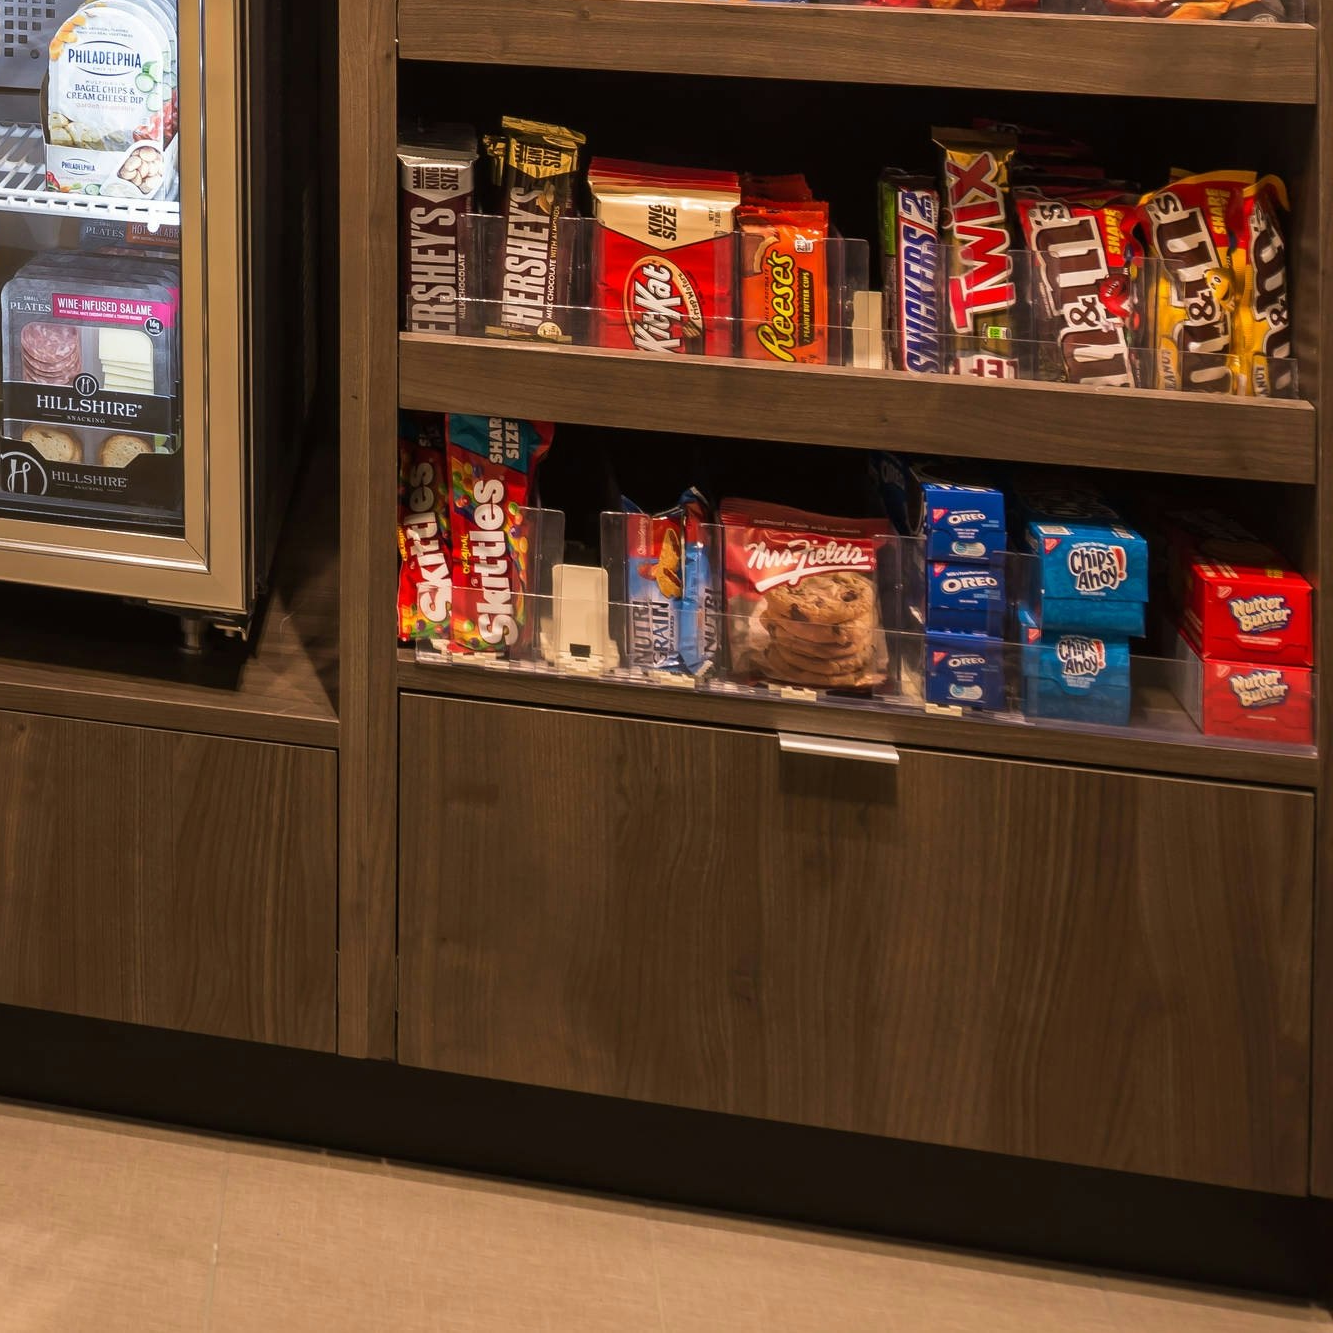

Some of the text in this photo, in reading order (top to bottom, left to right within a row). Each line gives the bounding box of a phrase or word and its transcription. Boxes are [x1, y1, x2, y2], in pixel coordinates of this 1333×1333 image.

[68, 48, 142, 68] PHILADELPHIA
[441, 168, 459, 191] SIZE
[551, 205, 560, 240] ALMONDS
[1204, 188, 1227, 235] SHARE
[85, 226, 125, 238] PLATES
[949, 153, 1015, 331] TWIX
[1102, 208, 1123, 256] SHARE
[501, 187, 551, 327] HERSHEY'S
[458, 253, 466, 301] CHOCOLATE
[547, 259, 557, 302] CHOCOLATE
[807, 272, 815, 288] CUPS
[10, 302, 52, 313] PLATES
[57, 297, 118, 313] WINE-INFUSED
[120, 303, 153, 317] SALAME
[546, 302, 555, 320] MILK
[757, 250, 795, 363] Reese's
[805, 288, 814, 313] BUTTER
[903, 226, 939, 374] SNICKERS
[805, 313, 813, 338] PEANUT
[37, 394, 138, 418] HILLSHIRE
[66, 416, 106, 425] SNACKING
[505, 420, 520, 460] SIZE
[51, 470, 128, 488] HILLSHIRE
[948, 512, 986, 526] OREO
[406, 462, 453, 622] Skittles
[469, 479, 519, 646] Skittles
[789, 539, 869, 585] Fields
[1069, 548, 1115, 570] Chips
[941, 575, 998, 594] OREO
[1232, 596, 1285, 617] Nutter
[634, 600, 648, 665] NUTRI
[652, 599, 670, 666] GRAIN
[702, 588, 720, 654] NUTRI
[1238, 611, 1291, 632] Butter
[948, 655, 986, 668] OREO
[1057, 640, 1095, 660] Chips
[1231, 671, 1282, 692] Nutter
[1238, 685, 1287, 707] Butter
